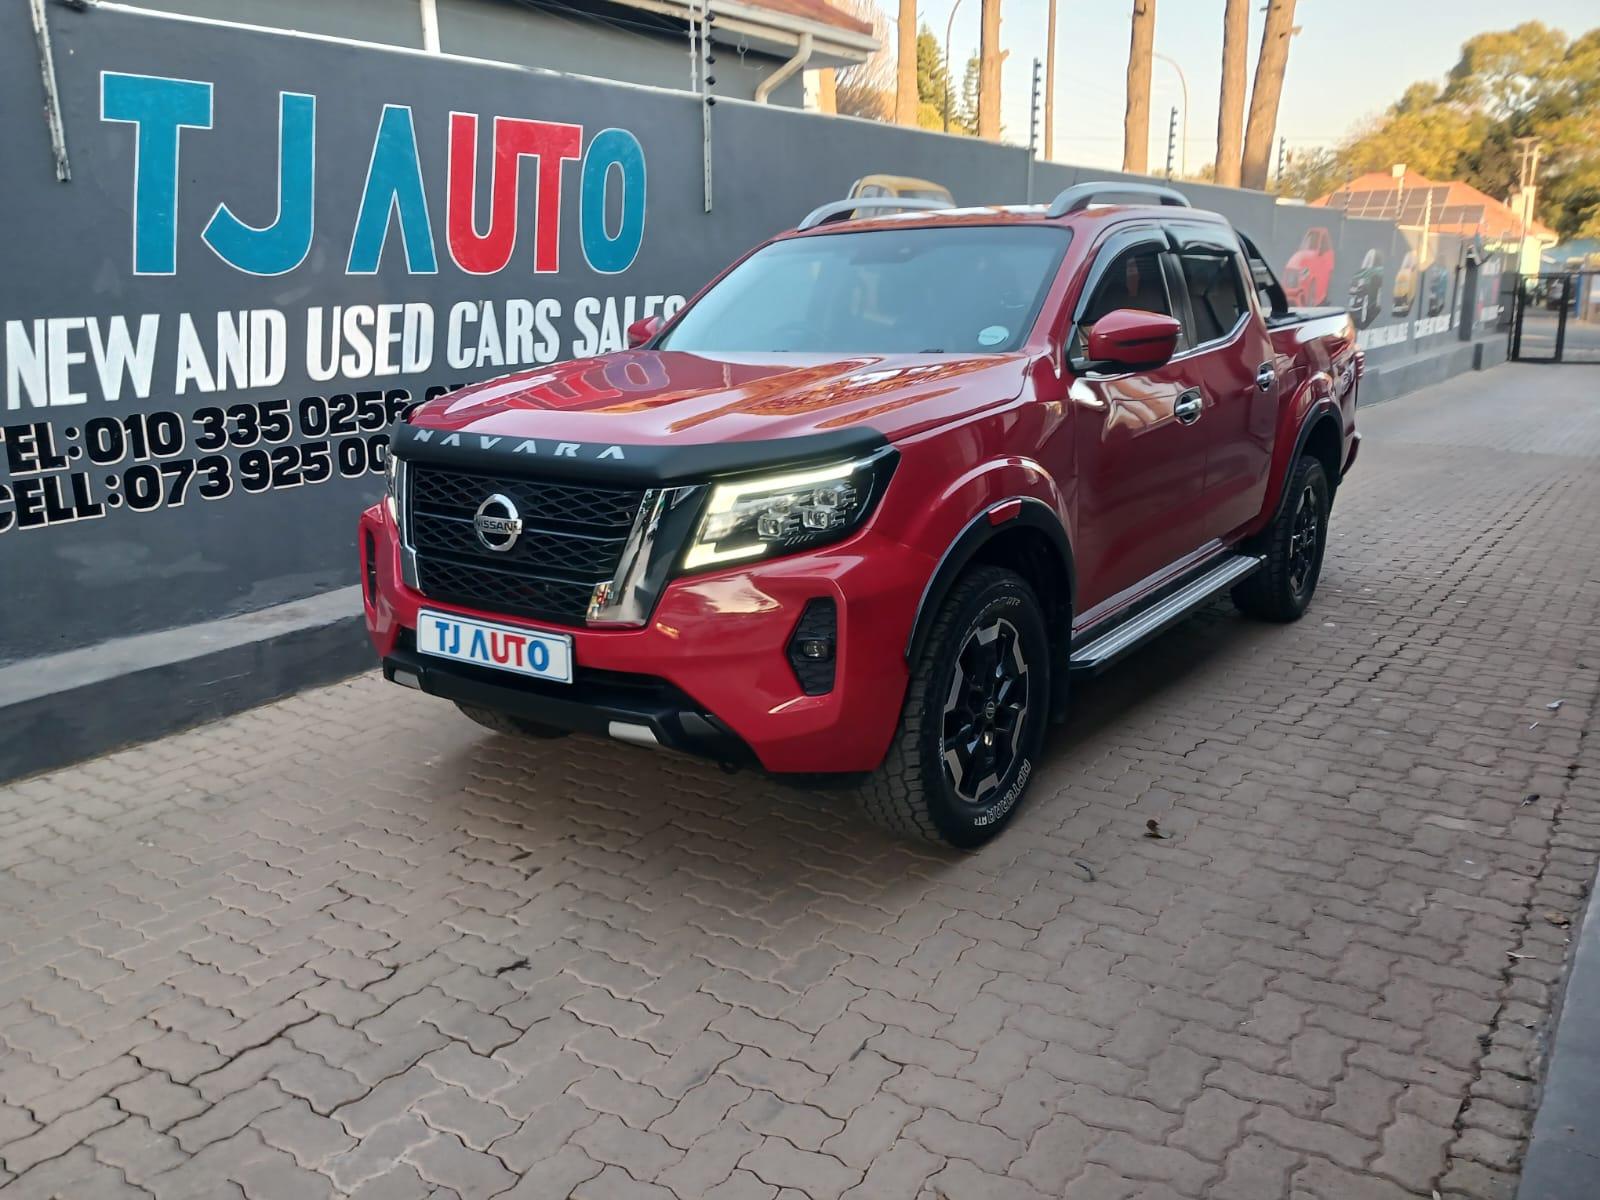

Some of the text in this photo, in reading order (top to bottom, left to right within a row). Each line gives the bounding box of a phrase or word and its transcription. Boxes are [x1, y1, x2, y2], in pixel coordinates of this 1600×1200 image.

[100, 70, 647, 276] TJ AUTO
[5, 312, 160, 410] NEW
[175, 308, 287, 394] AND
[306, 302, 435, 382] USED
[447, 299, 562, 369] CARS
[191, 400, 294, 452] 335
[299, 388, 412, 438] 0256
[413, 429, 625, 460] NAVARA
[240, 446, 333, 492] 925
[435, 621, 550, 672] TJ AUTO
